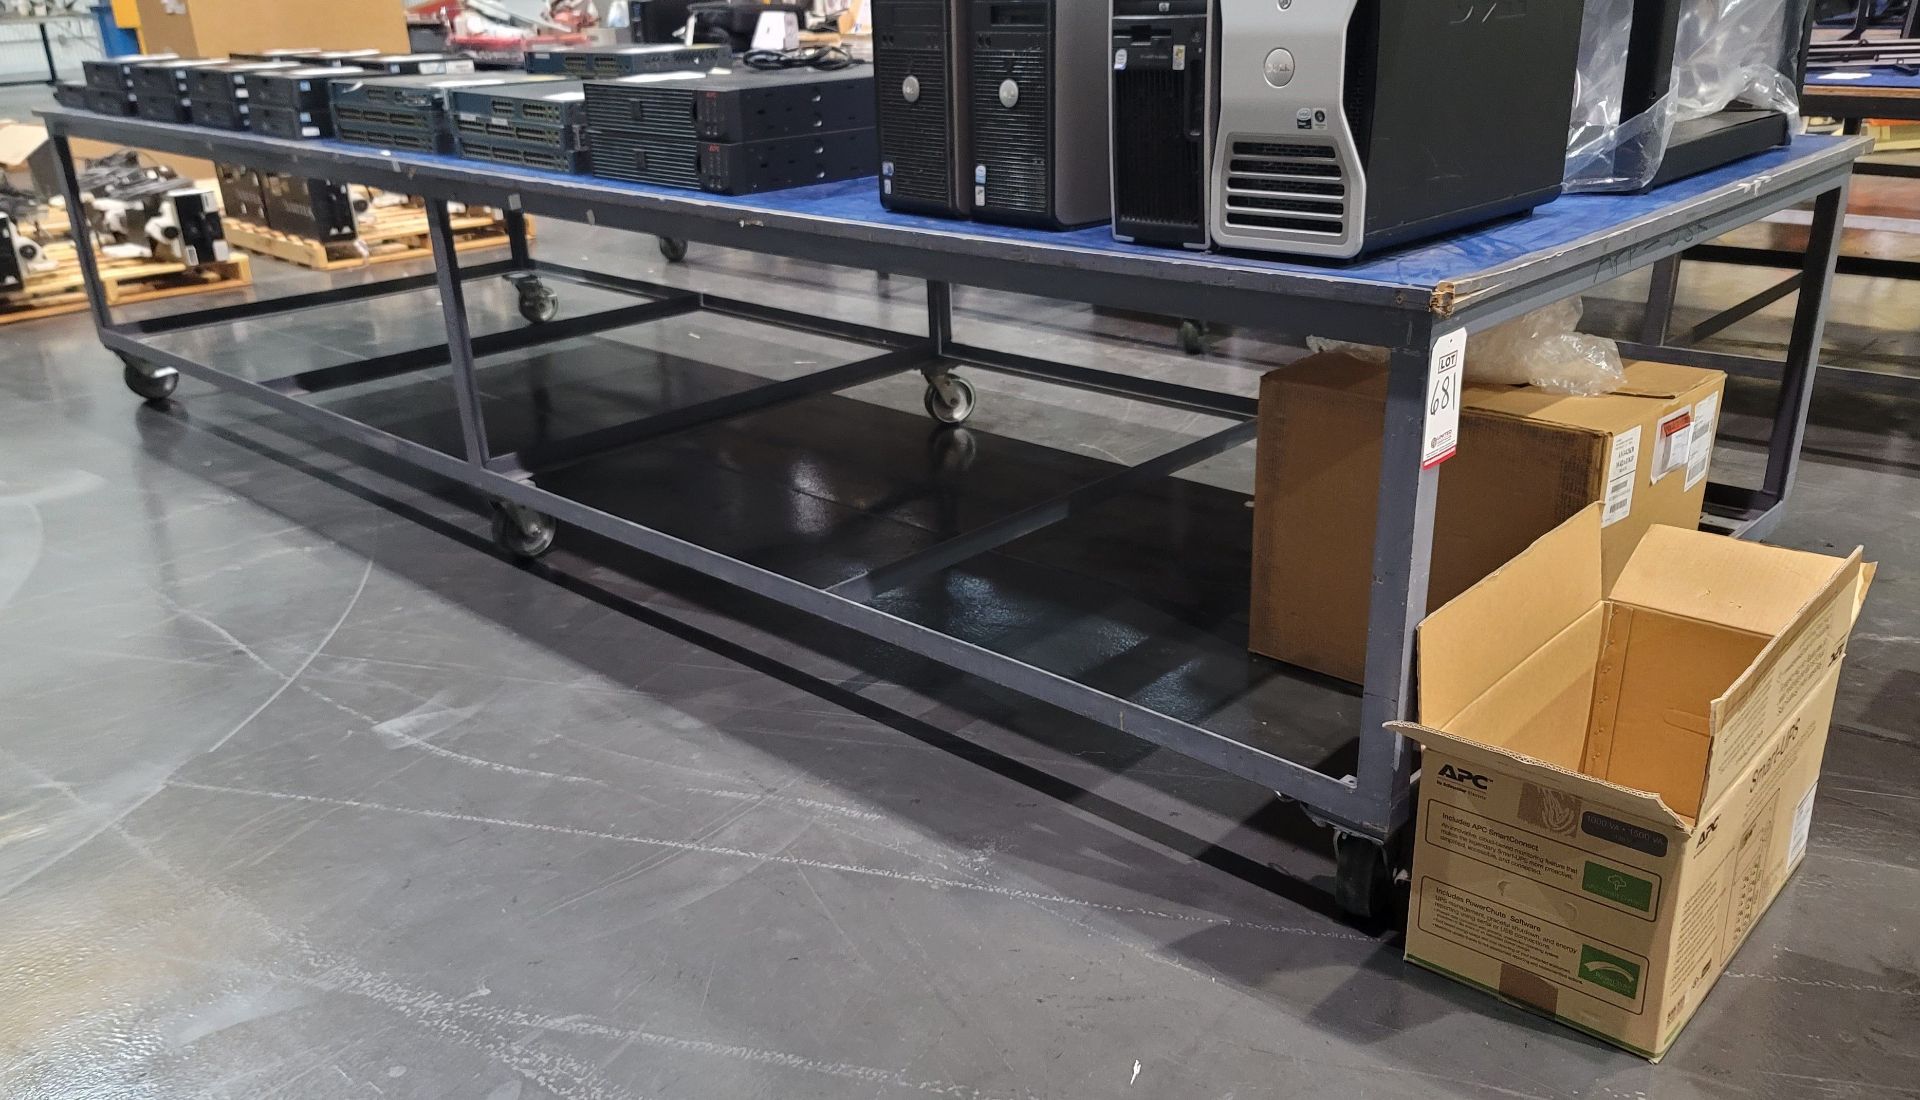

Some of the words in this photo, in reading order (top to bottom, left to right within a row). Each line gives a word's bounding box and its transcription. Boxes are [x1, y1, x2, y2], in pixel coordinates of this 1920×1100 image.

[1440, 354, 1456, 369] LOT
[1430, 372, 1456, 415] 681
[1438, 764, 1488, 790] APC
[1442, 812, 1470, 827] Includes
[1472, 822, 1487, 833] APC
[1488, 828, 1538, 851] SmartConnect
[1436, 887, 1463, 902] Includes
[1465, 898, 1506, 918] PowerChute
[1509, 914, 1541, 932] Software
[1542, 936, 1554, 944] and
[1555, 942, 1576, 954] energy
